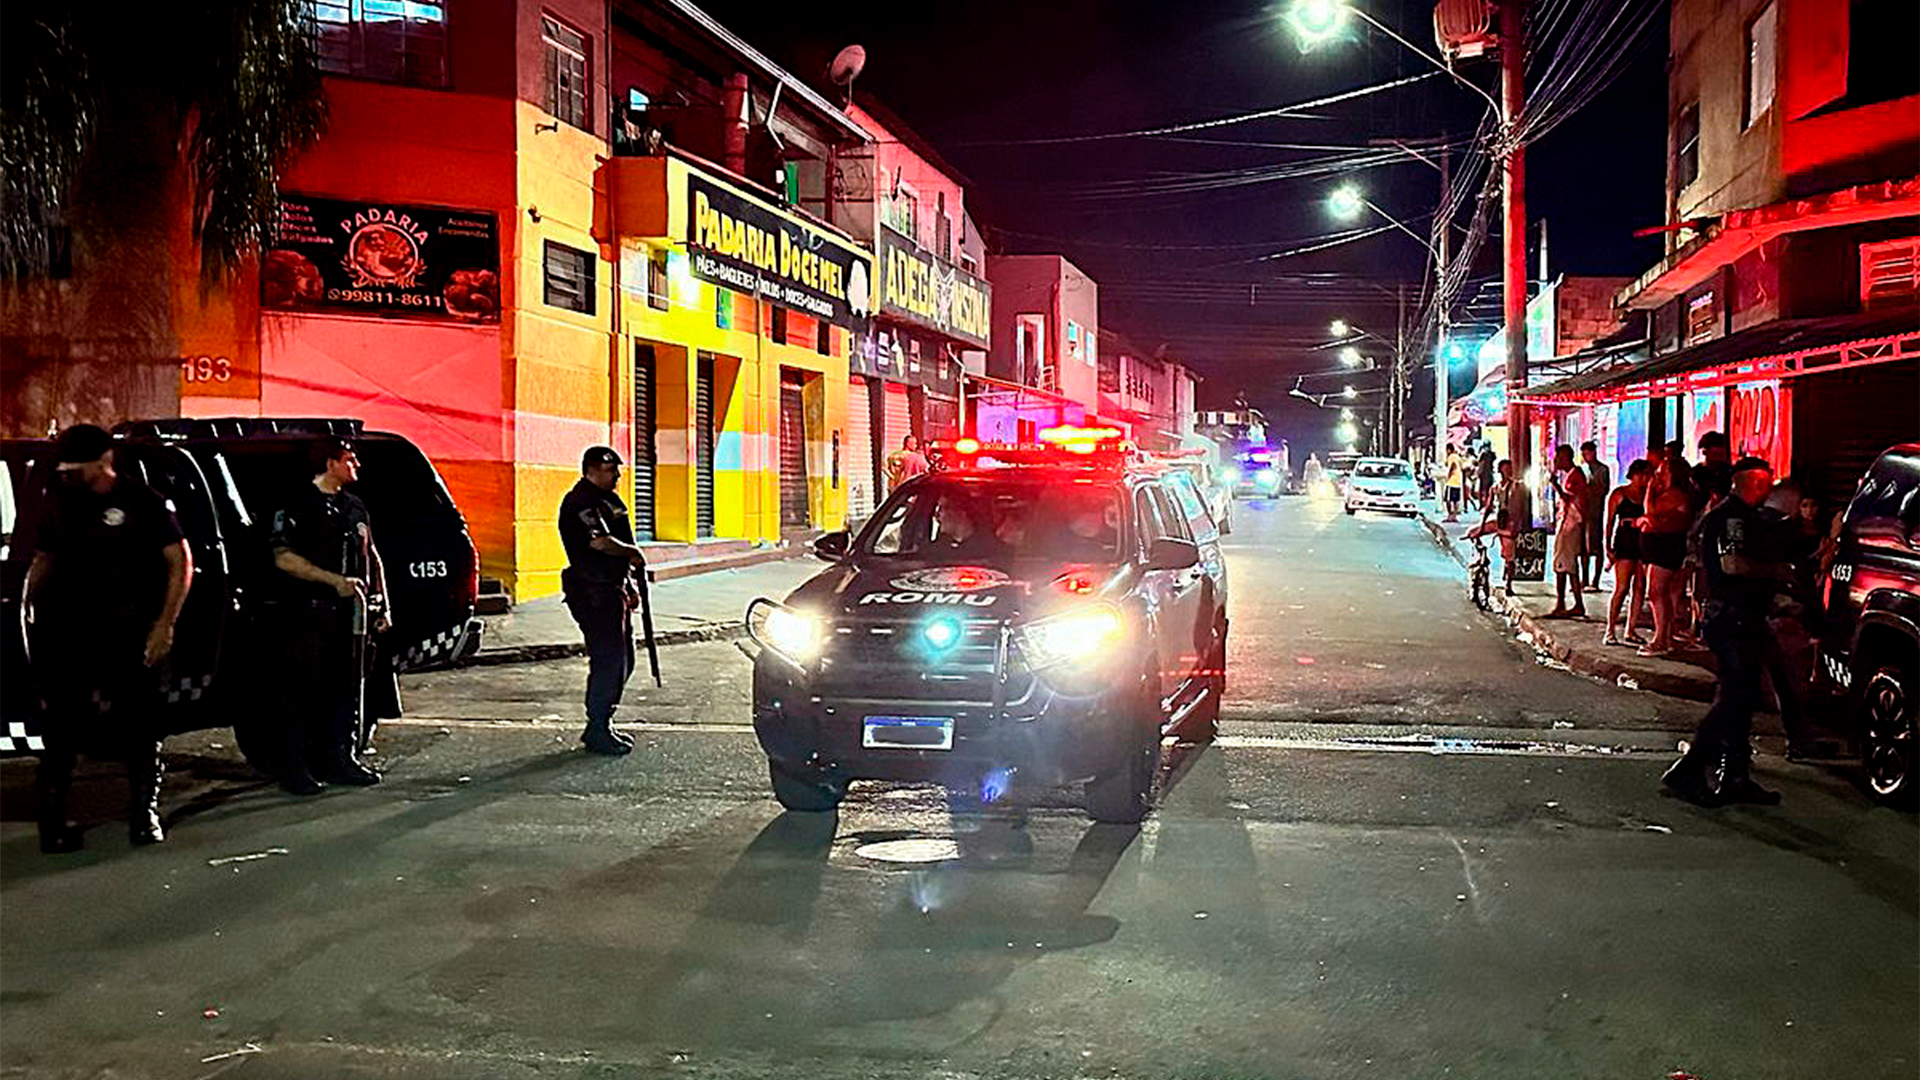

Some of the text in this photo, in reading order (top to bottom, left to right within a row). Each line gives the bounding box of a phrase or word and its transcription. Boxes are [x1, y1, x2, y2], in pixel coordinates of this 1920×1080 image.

[340, 208, 429, 245] PADARIA
[695, 190, 777, 273] PADARIA
[885, 244, 939, 321] ADEGA
[341, 289, 441, 308] 99811-8611
[181, 356, 232, 382] 193
[417, 560, 448, 578] 153
[859, 591, 997, 606] ROMU
